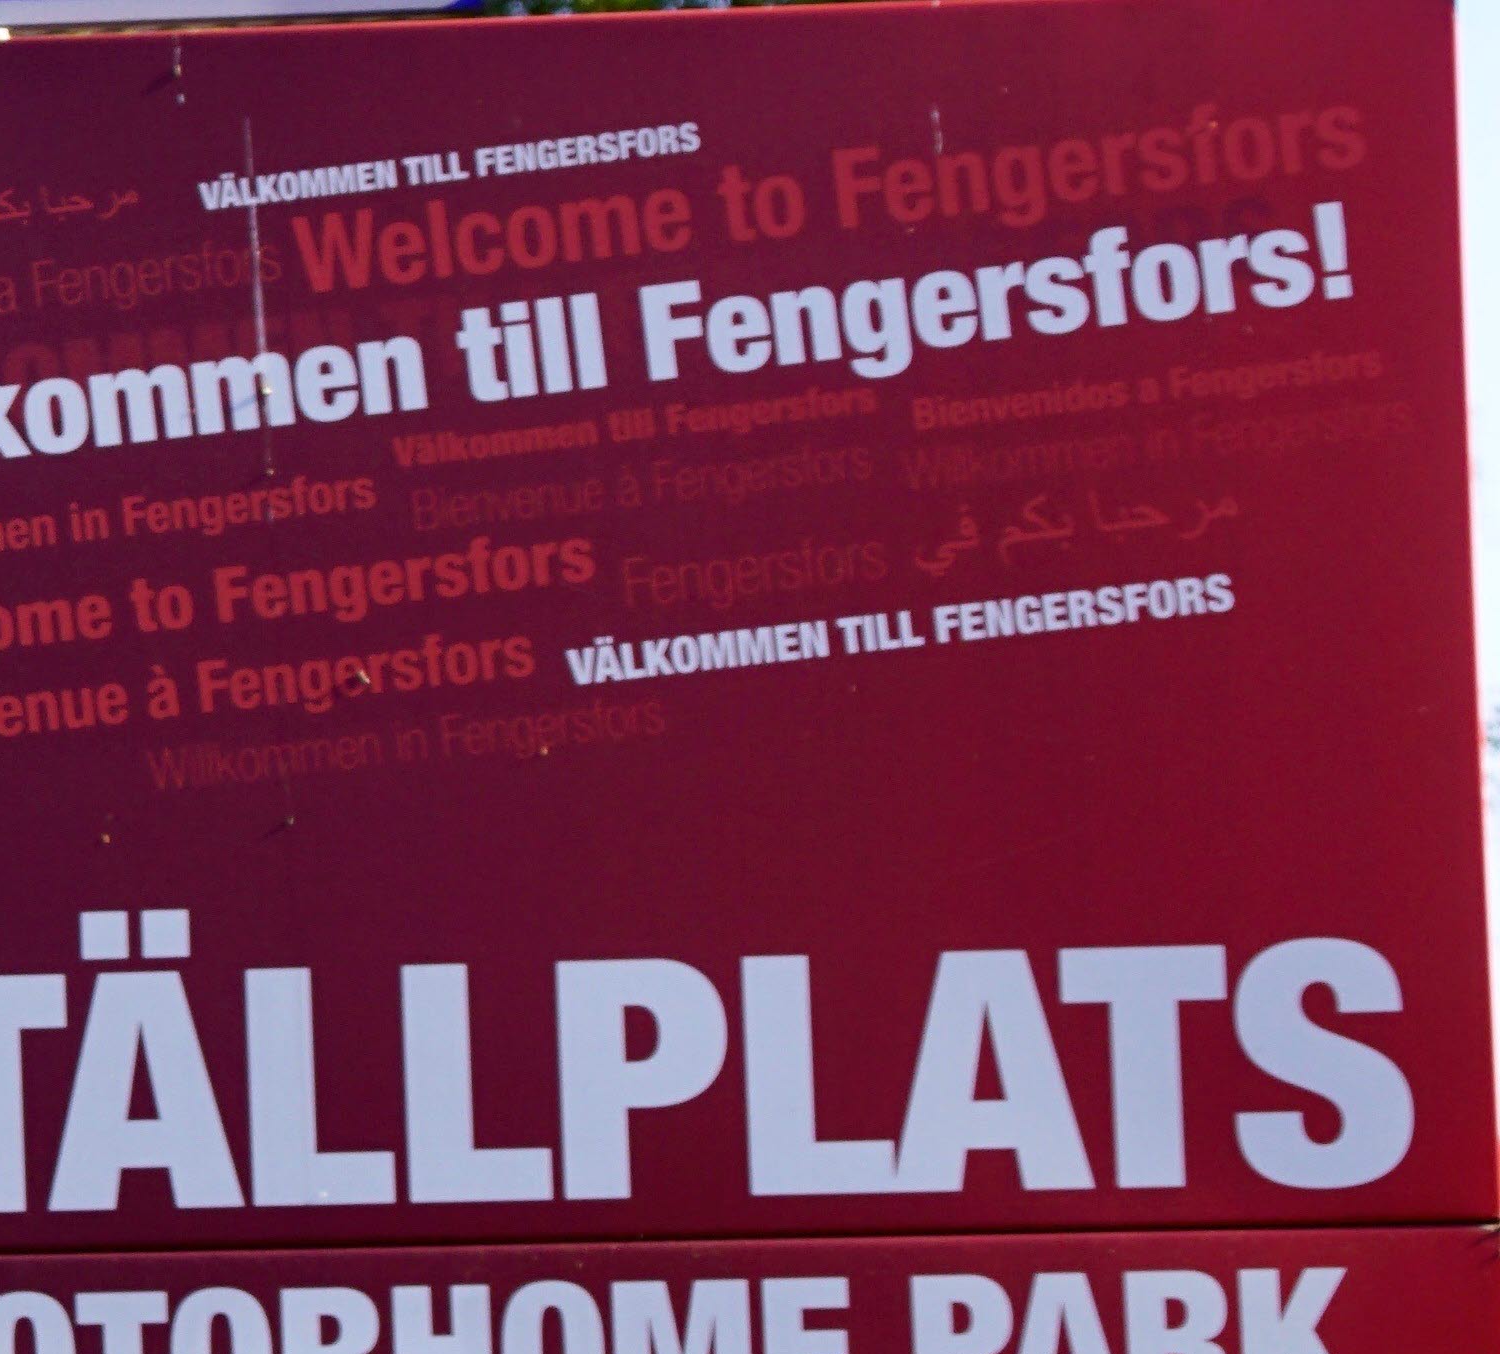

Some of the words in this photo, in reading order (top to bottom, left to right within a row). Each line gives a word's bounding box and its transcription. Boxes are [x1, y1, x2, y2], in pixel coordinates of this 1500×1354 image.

[198, 157, 398, 211] VÄLKOMMEN
[403, 150, 469, 187] TILL
[476, 121, 701, 177] FENGERSFORS
[292, 186, 693, 294] Welcome
[719, 165, 804, 240] to
[831, 105, 1367, 228] Fengersfors
[32, 239, 282, 307] Fengersfors
[456, 292, 607, 404] till
[638, 201, 1357, 380] Fengersfors!
[393, 416, 600, 468] Välkommen
[608, 408, 658, 444] till
[664, 386, 877, 440] Fengersfors
[70, 502, 109, 542] in
[122, 475, 377, 542] Fengersfors
[411, 474, 606, 532] Bienvenue
[130, 576, 192, 633] to
[215, 534, 595, 624] Fengersfors
[566, 619, 831, 687] VÄLKOMMEN
[838, 609, 925, 655] TILL
[934, 573, 1235, 644] FENGERSFORS
[148, 660, 180, 720] à
[199, 636, 535, 715] Fengersfors
